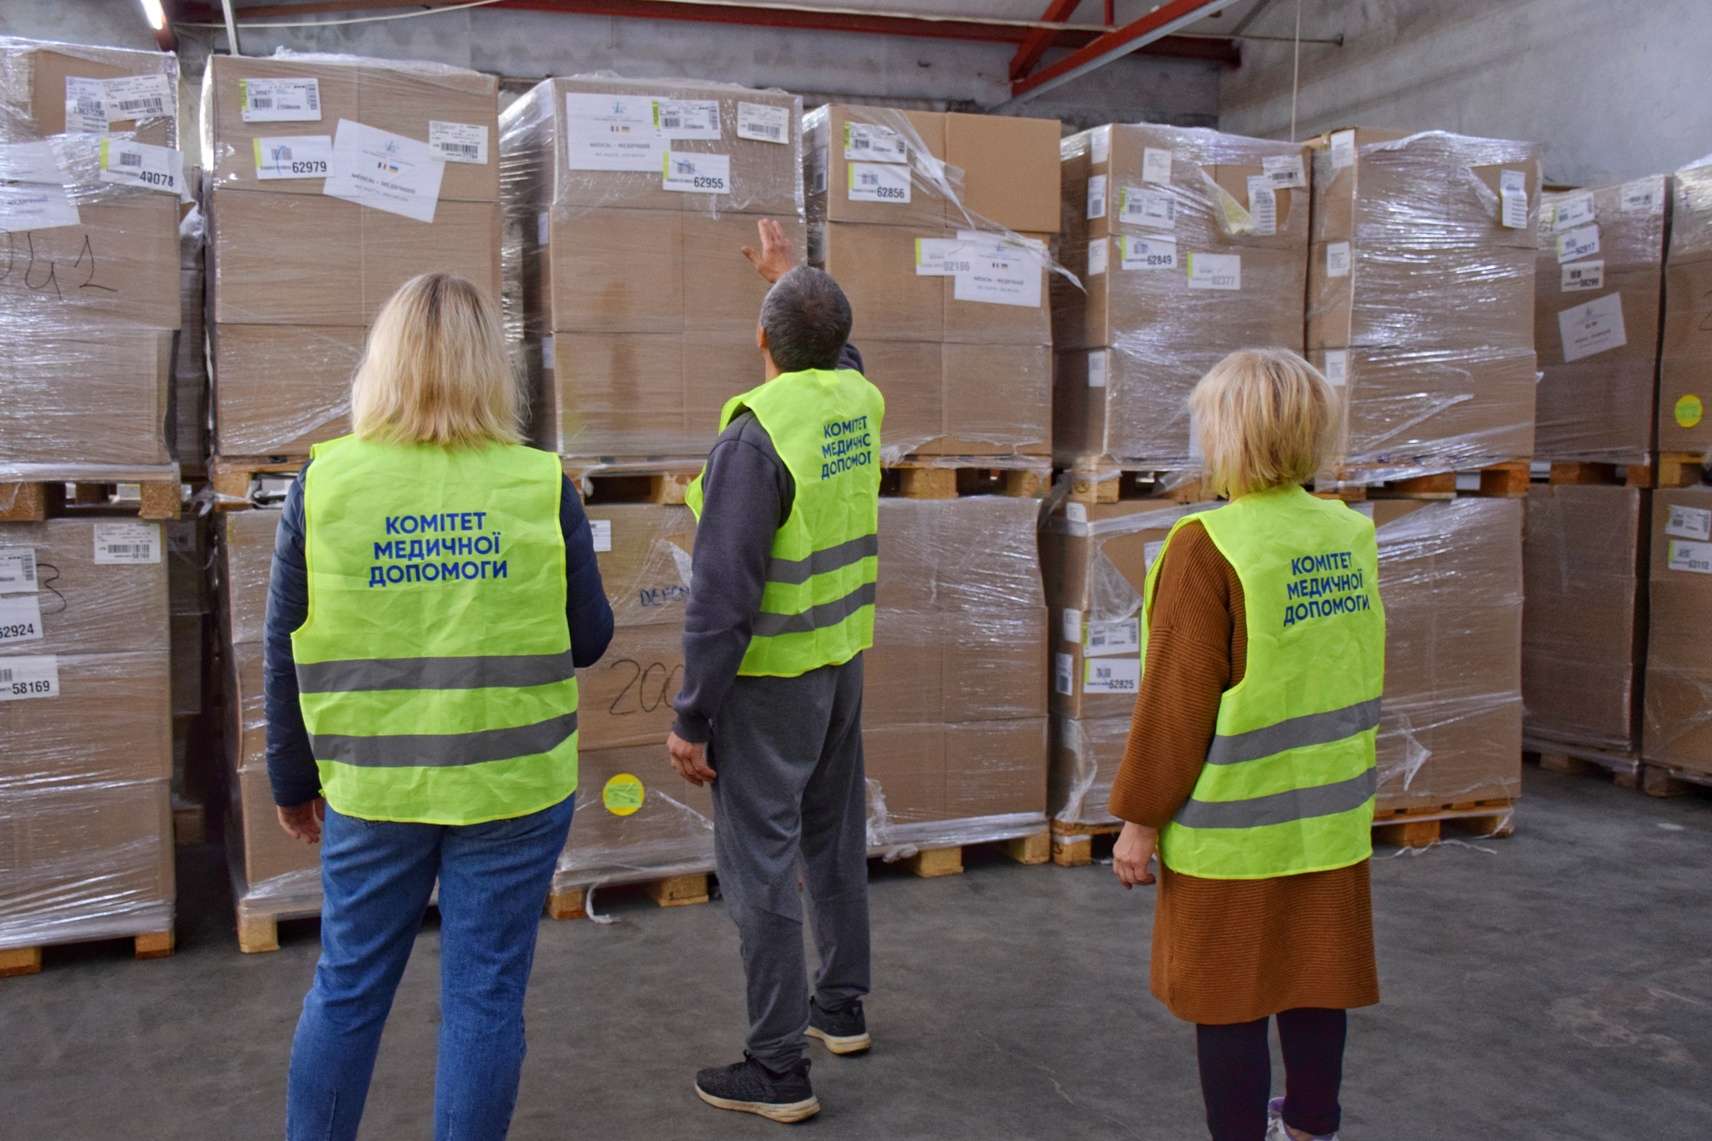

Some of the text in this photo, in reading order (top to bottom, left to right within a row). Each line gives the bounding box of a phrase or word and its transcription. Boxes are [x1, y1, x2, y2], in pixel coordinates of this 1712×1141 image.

[292, 160, 328, 174] 62979
[693, 176, 725, 189] 62955
[876, 185, 906, 200] 62856
[823, 415, 868, 439] КОМІТЕТ
[385, 511, 487, 536] КОМІТЕТ
[373, 531, 502, 561] МЕДИЧНОЇ
[368, 560, 508, 588] ДОПОМОГИ
[1291, 551, 1352, 576] КОМІТЕТ
[1286, 568, 1363, 600] МЕДИЧНОЇ
[1283, 594, 1371, 627] ДОПОМОГИ
[12, 679, 51, 696] 58169
